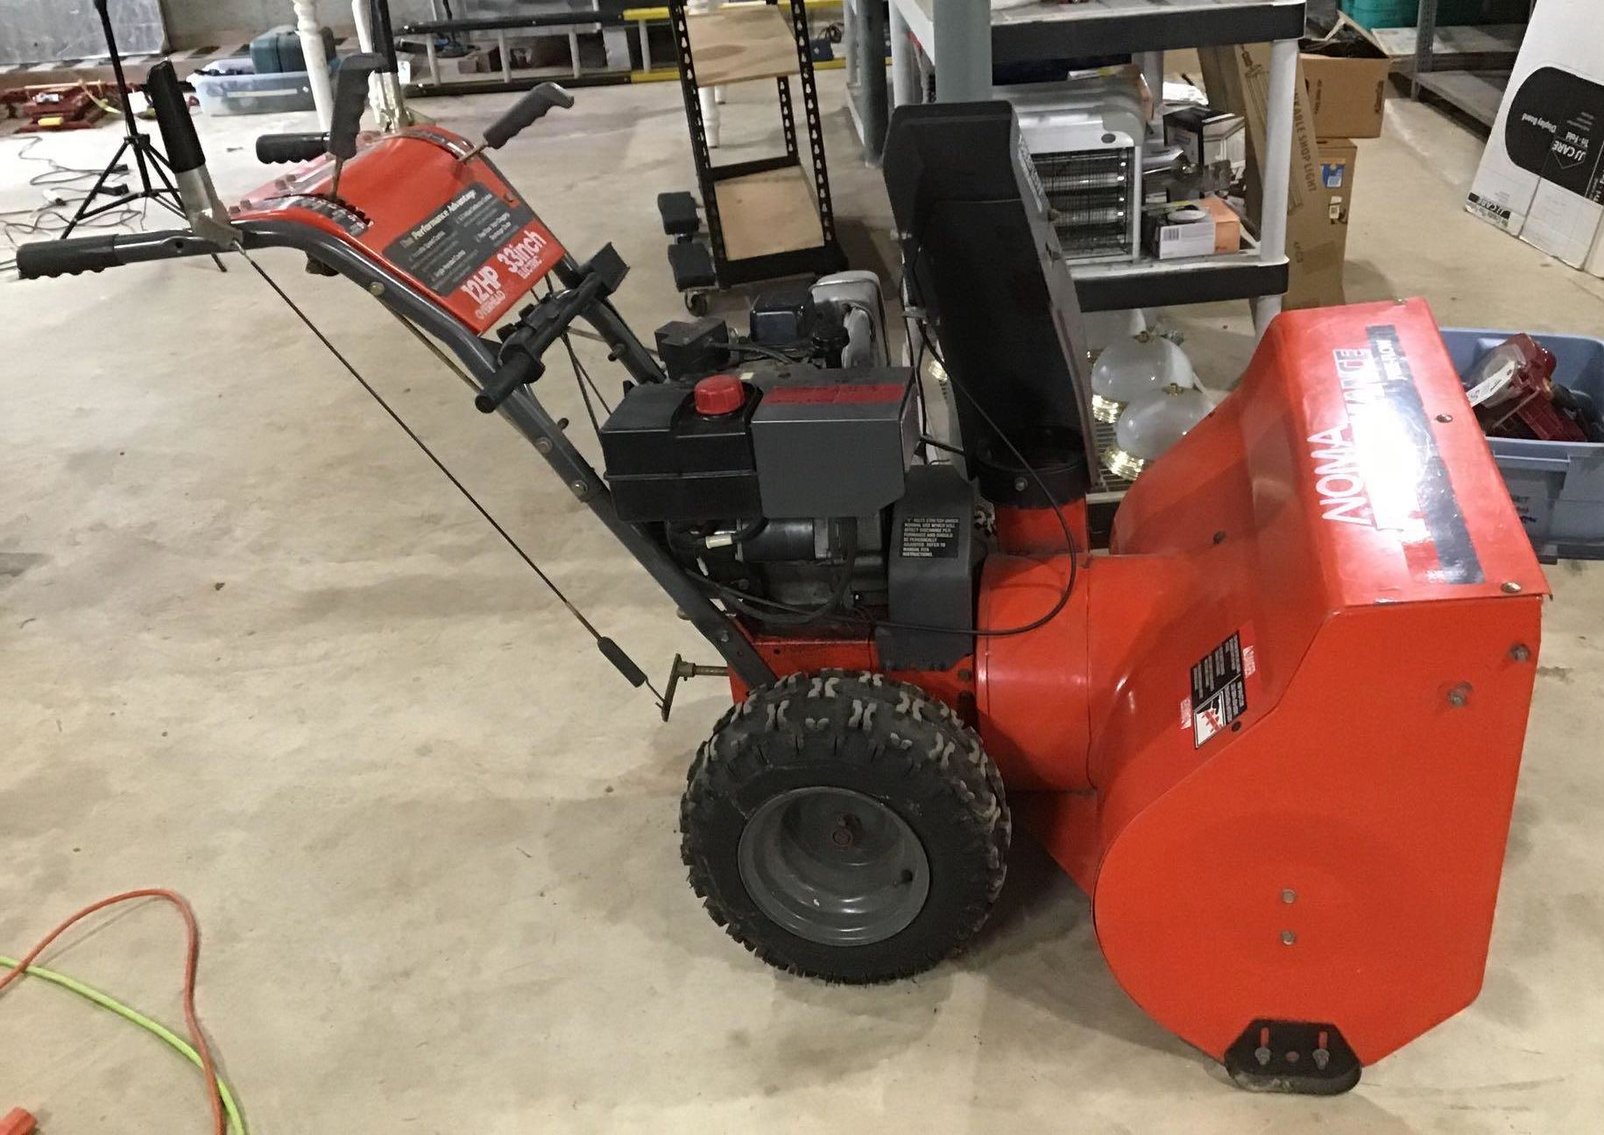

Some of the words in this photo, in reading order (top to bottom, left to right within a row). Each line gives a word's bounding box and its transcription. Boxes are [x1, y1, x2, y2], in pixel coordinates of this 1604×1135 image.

[1537, 118, 1557, 133] Display
[1552, 140, 1576, 157] CARE
[1574, 151, 1586, 161] JJ
[1298, 134, 1310, 160] SHOP
[1304, 164, 1317, 192] LIGHT
[411, 209, 450, 240] Performance
[1307, 423, 1374, 527] NOMA
